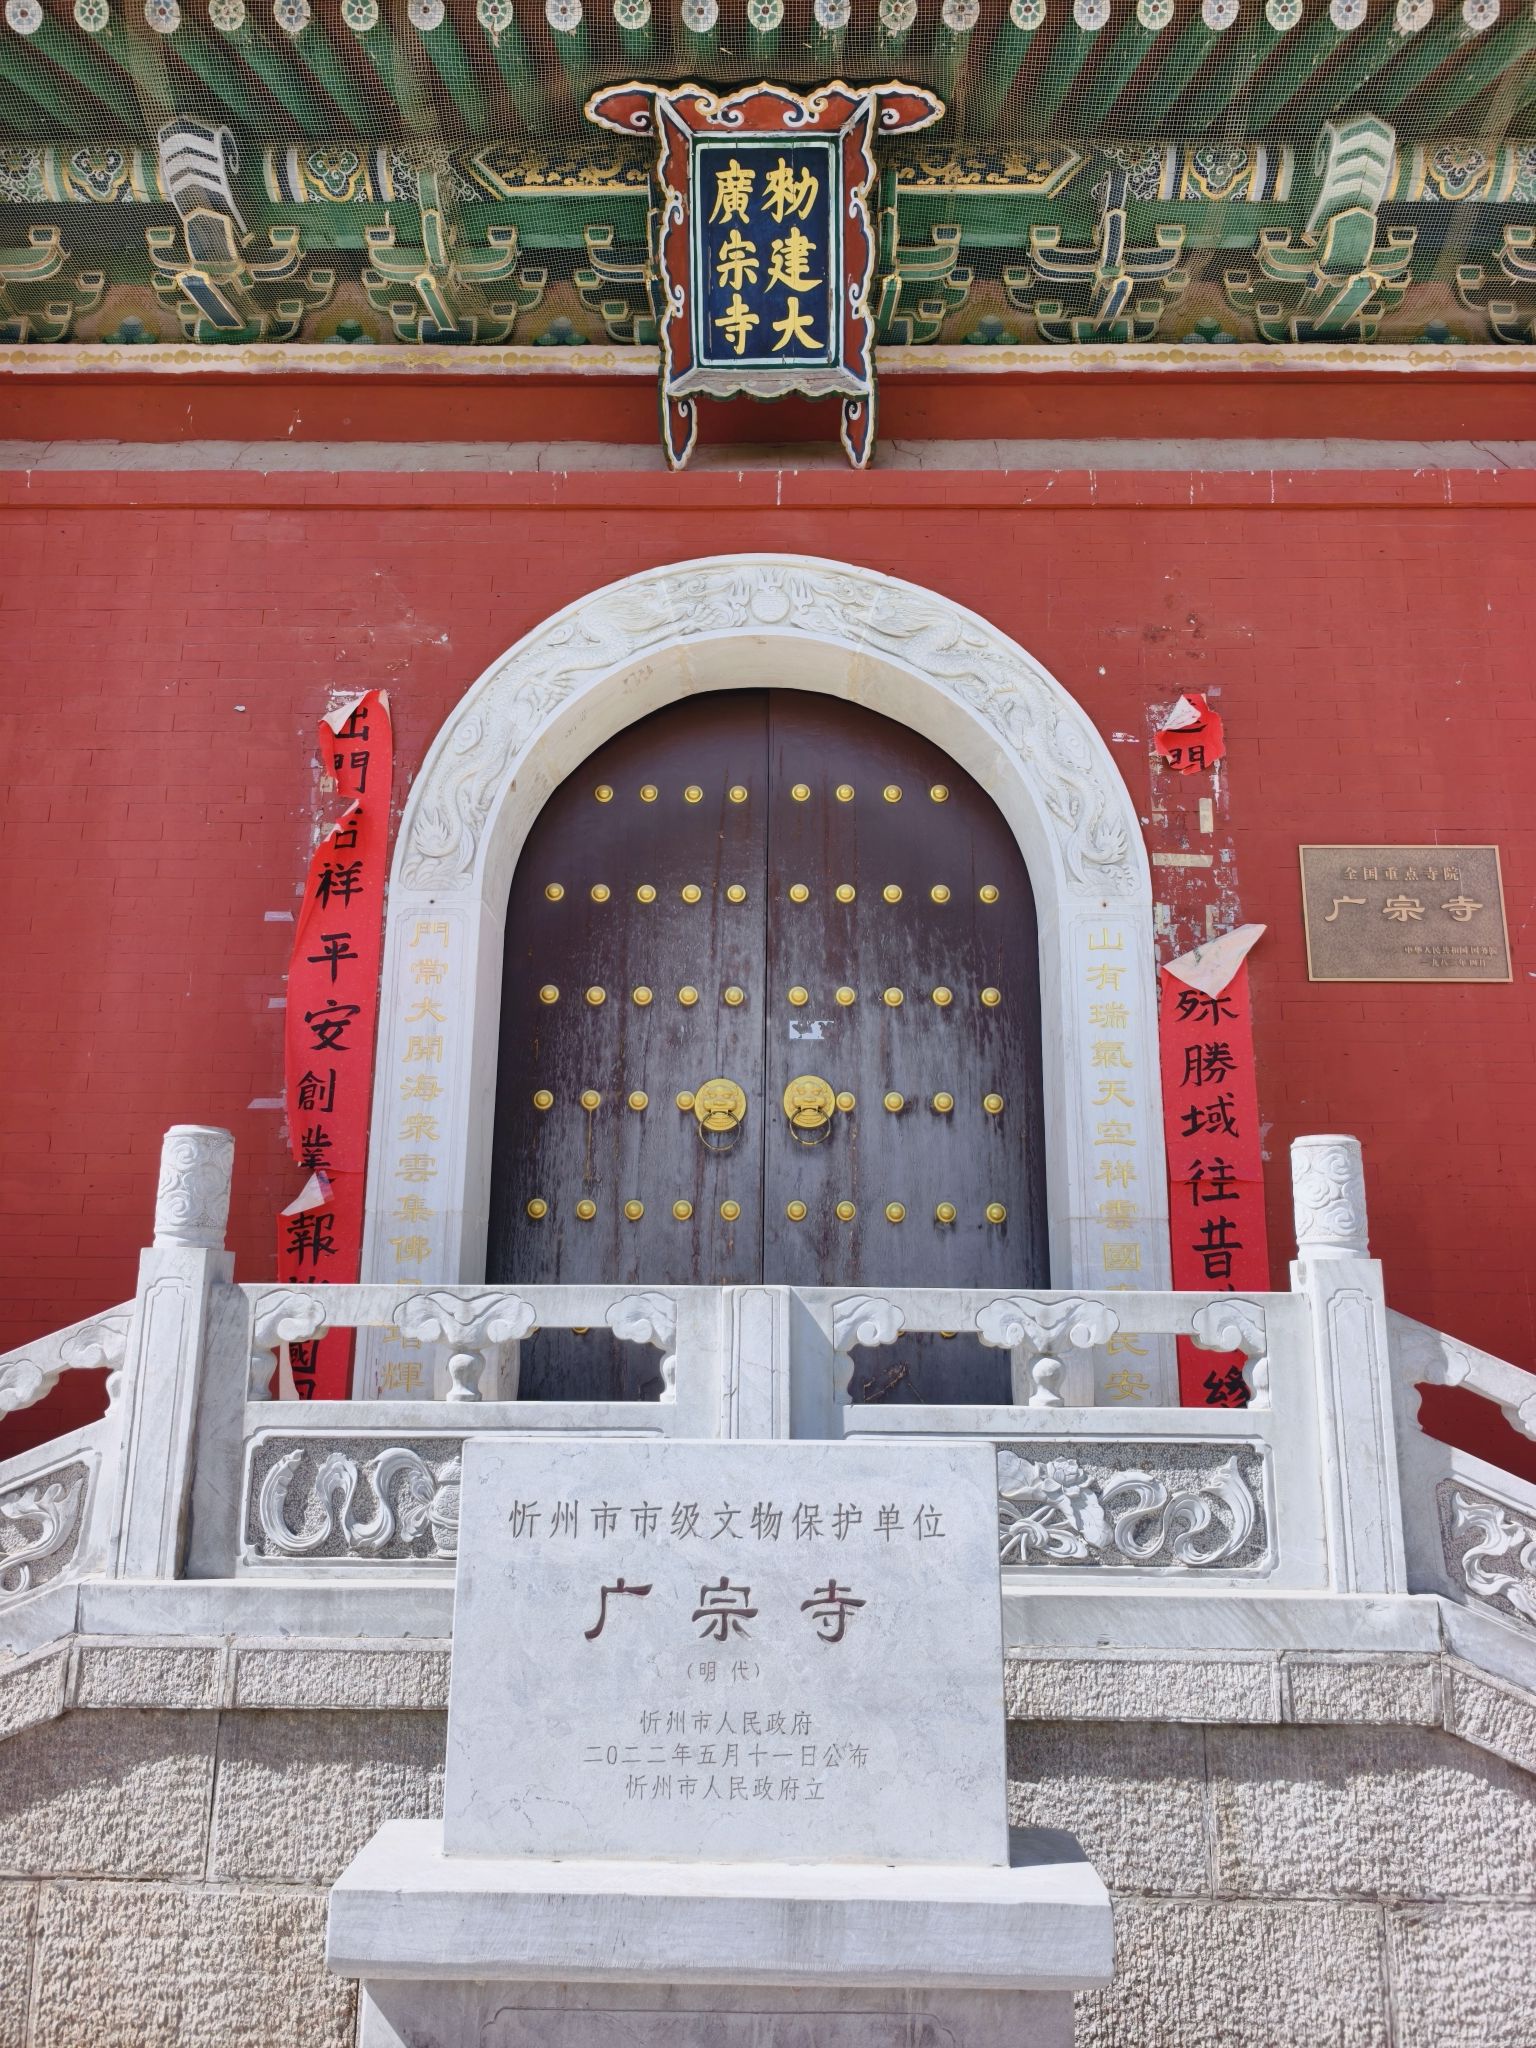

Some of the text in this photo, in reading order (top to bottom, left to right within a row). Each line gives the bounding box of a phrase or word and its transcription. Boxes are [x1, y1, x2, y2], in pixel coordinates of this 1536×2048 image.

[708, 158, 761, 356] 廣宗寺
[1342, 866, 1461, 882] 全国重点寺院
[1324, 894, 1484, 923] 广宗寺
[508, 1499, 947, 1542] 忻州市市级文物保护单位
[584, 1576, 868, 1643] 广宗寺
[639, 1709, 813, 1737] 忻州市人民政府
[625, 1774, 826, 1802] 忻州市人民政府立
